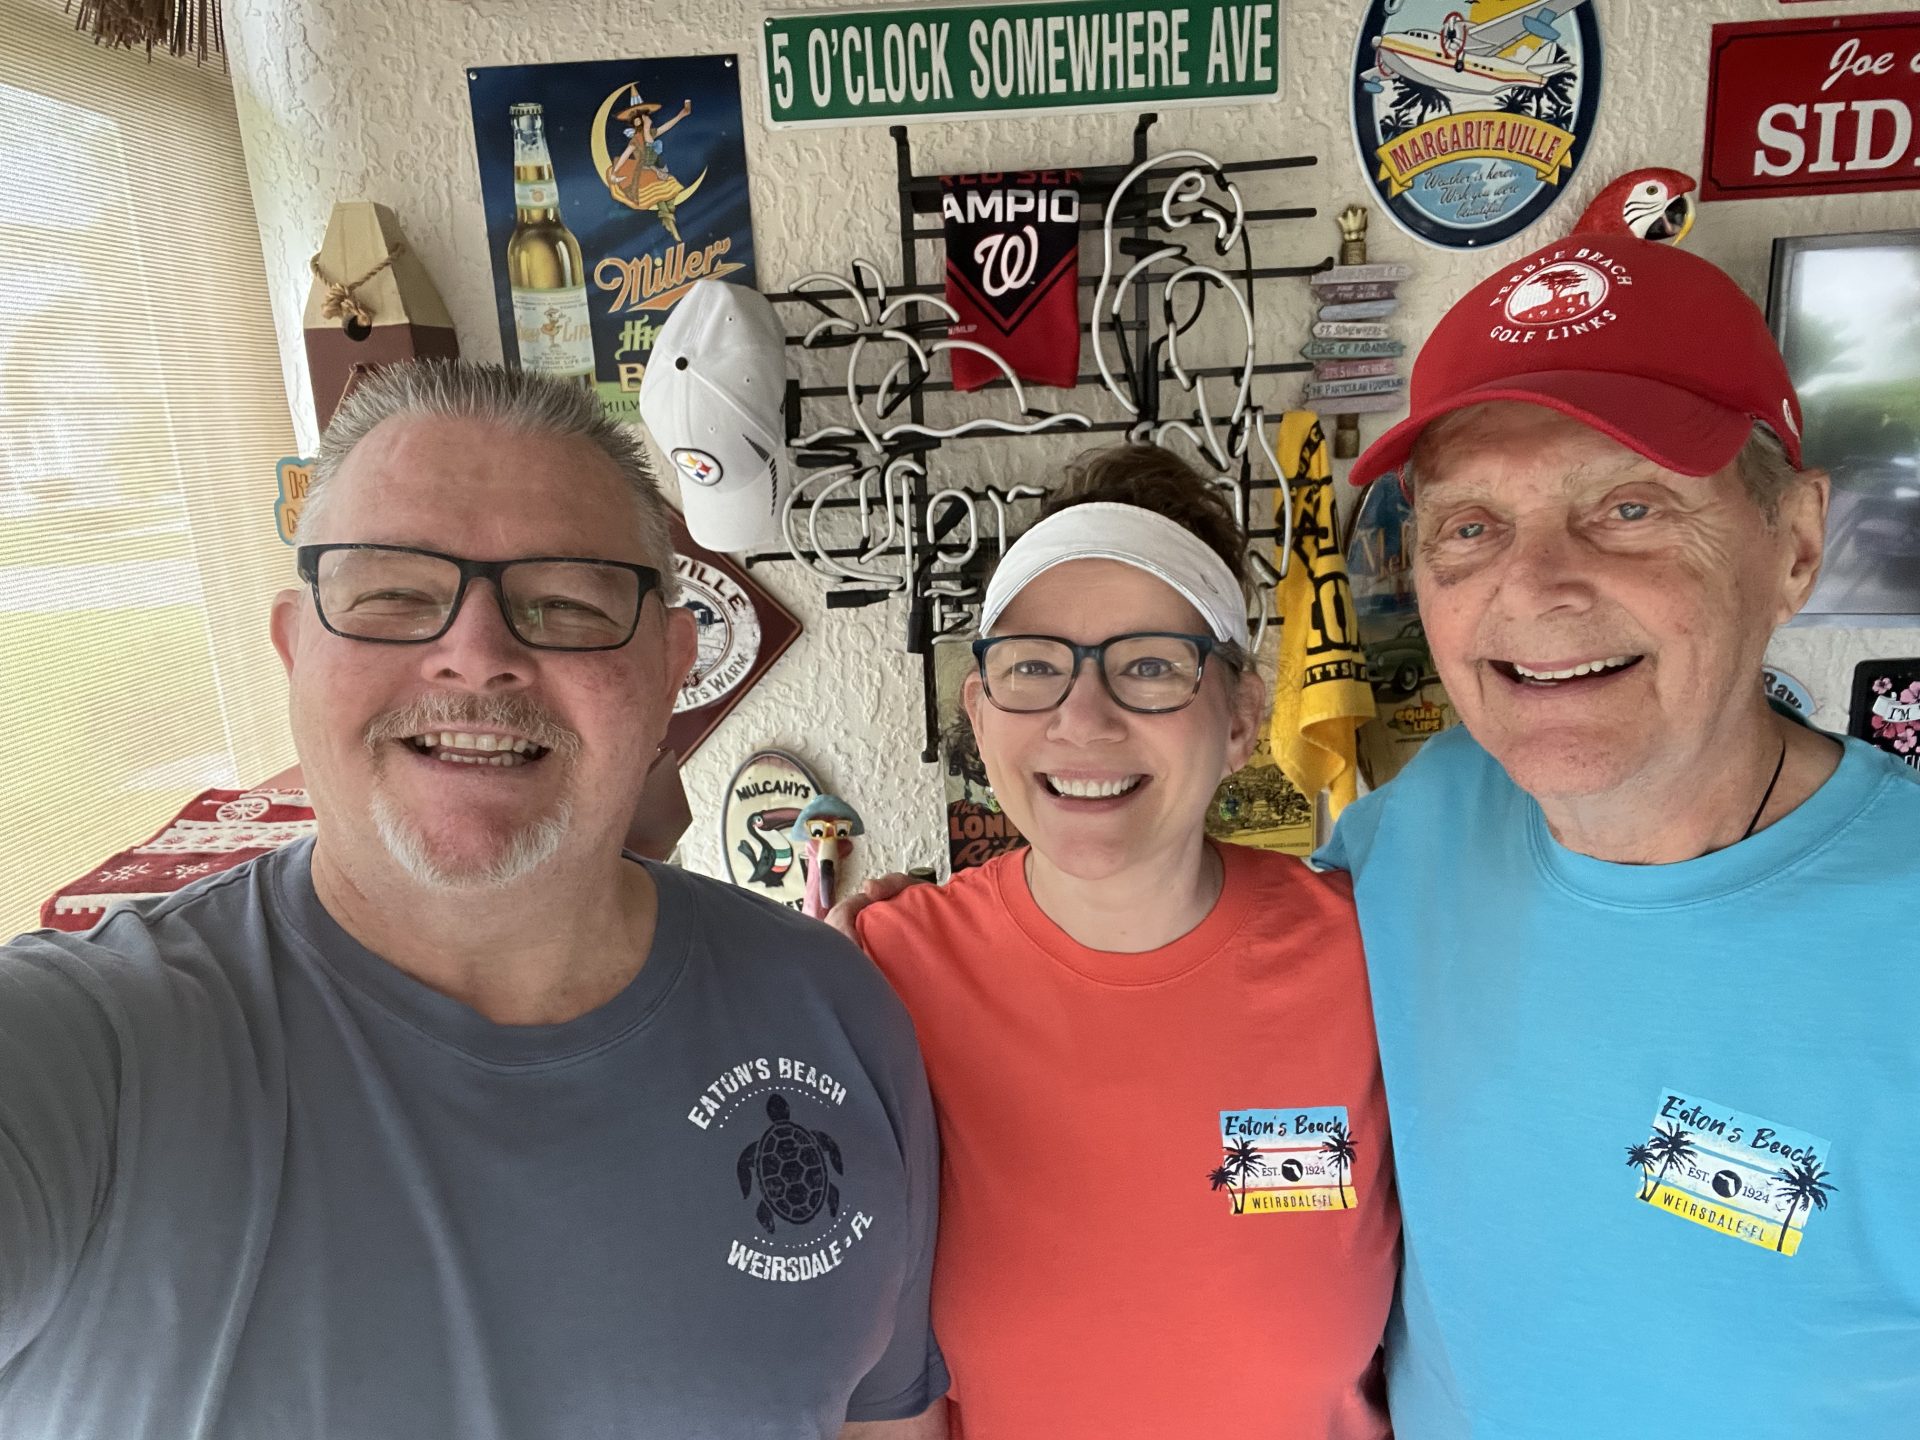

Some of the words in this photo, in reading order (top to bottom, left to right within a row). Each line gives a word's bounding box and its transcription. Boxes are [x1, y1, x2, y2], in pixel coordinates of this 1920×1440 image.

[771, 33, 793, 109] 5
[808, 22, 954, 107] O'CLOCK
[969, 9, 1190, 99] SOMEWHERE
[1206, 4, 1274, 84] AVE
[1820, 37, 1895, 91] Joe
[1754, 99, 1920, 177] SID
[593, 236, 732, 314] Miller
[1574, 247, 1633, 286] BEACH
[1490, 325, 1537, 343] GOLF
[1546, 309, 1617, 341] LINKS
[707, 652, 750, 694] WARM
[687, 1057, 772, 1130] EATON'S
[778, 1056, 848, 1106] BEACH
[1225, 1115, 1287, 1137] Eaton's
[1294, 1114, 1343, 1135] Beach
[1660, 1095, 1745, 1144] Eaton's
[1750, 1127, 1820, 1167] Beach
[1261, 1167, 1281, 1177] EST.
[1304, 1165, 1326, 1176] 1924
[1686, 1166, 1710, 1184] EST.
[1742, 1186, 1770, 1204] 1924
[1252, 1195, 1318, 1209] WEIRSDALE
[1663, 1192, 1744, 1234] WEIRSDALE
[727, 1239, 844, 1283] WEIRSDALE
[850, 1211, 874, 1241] FL
